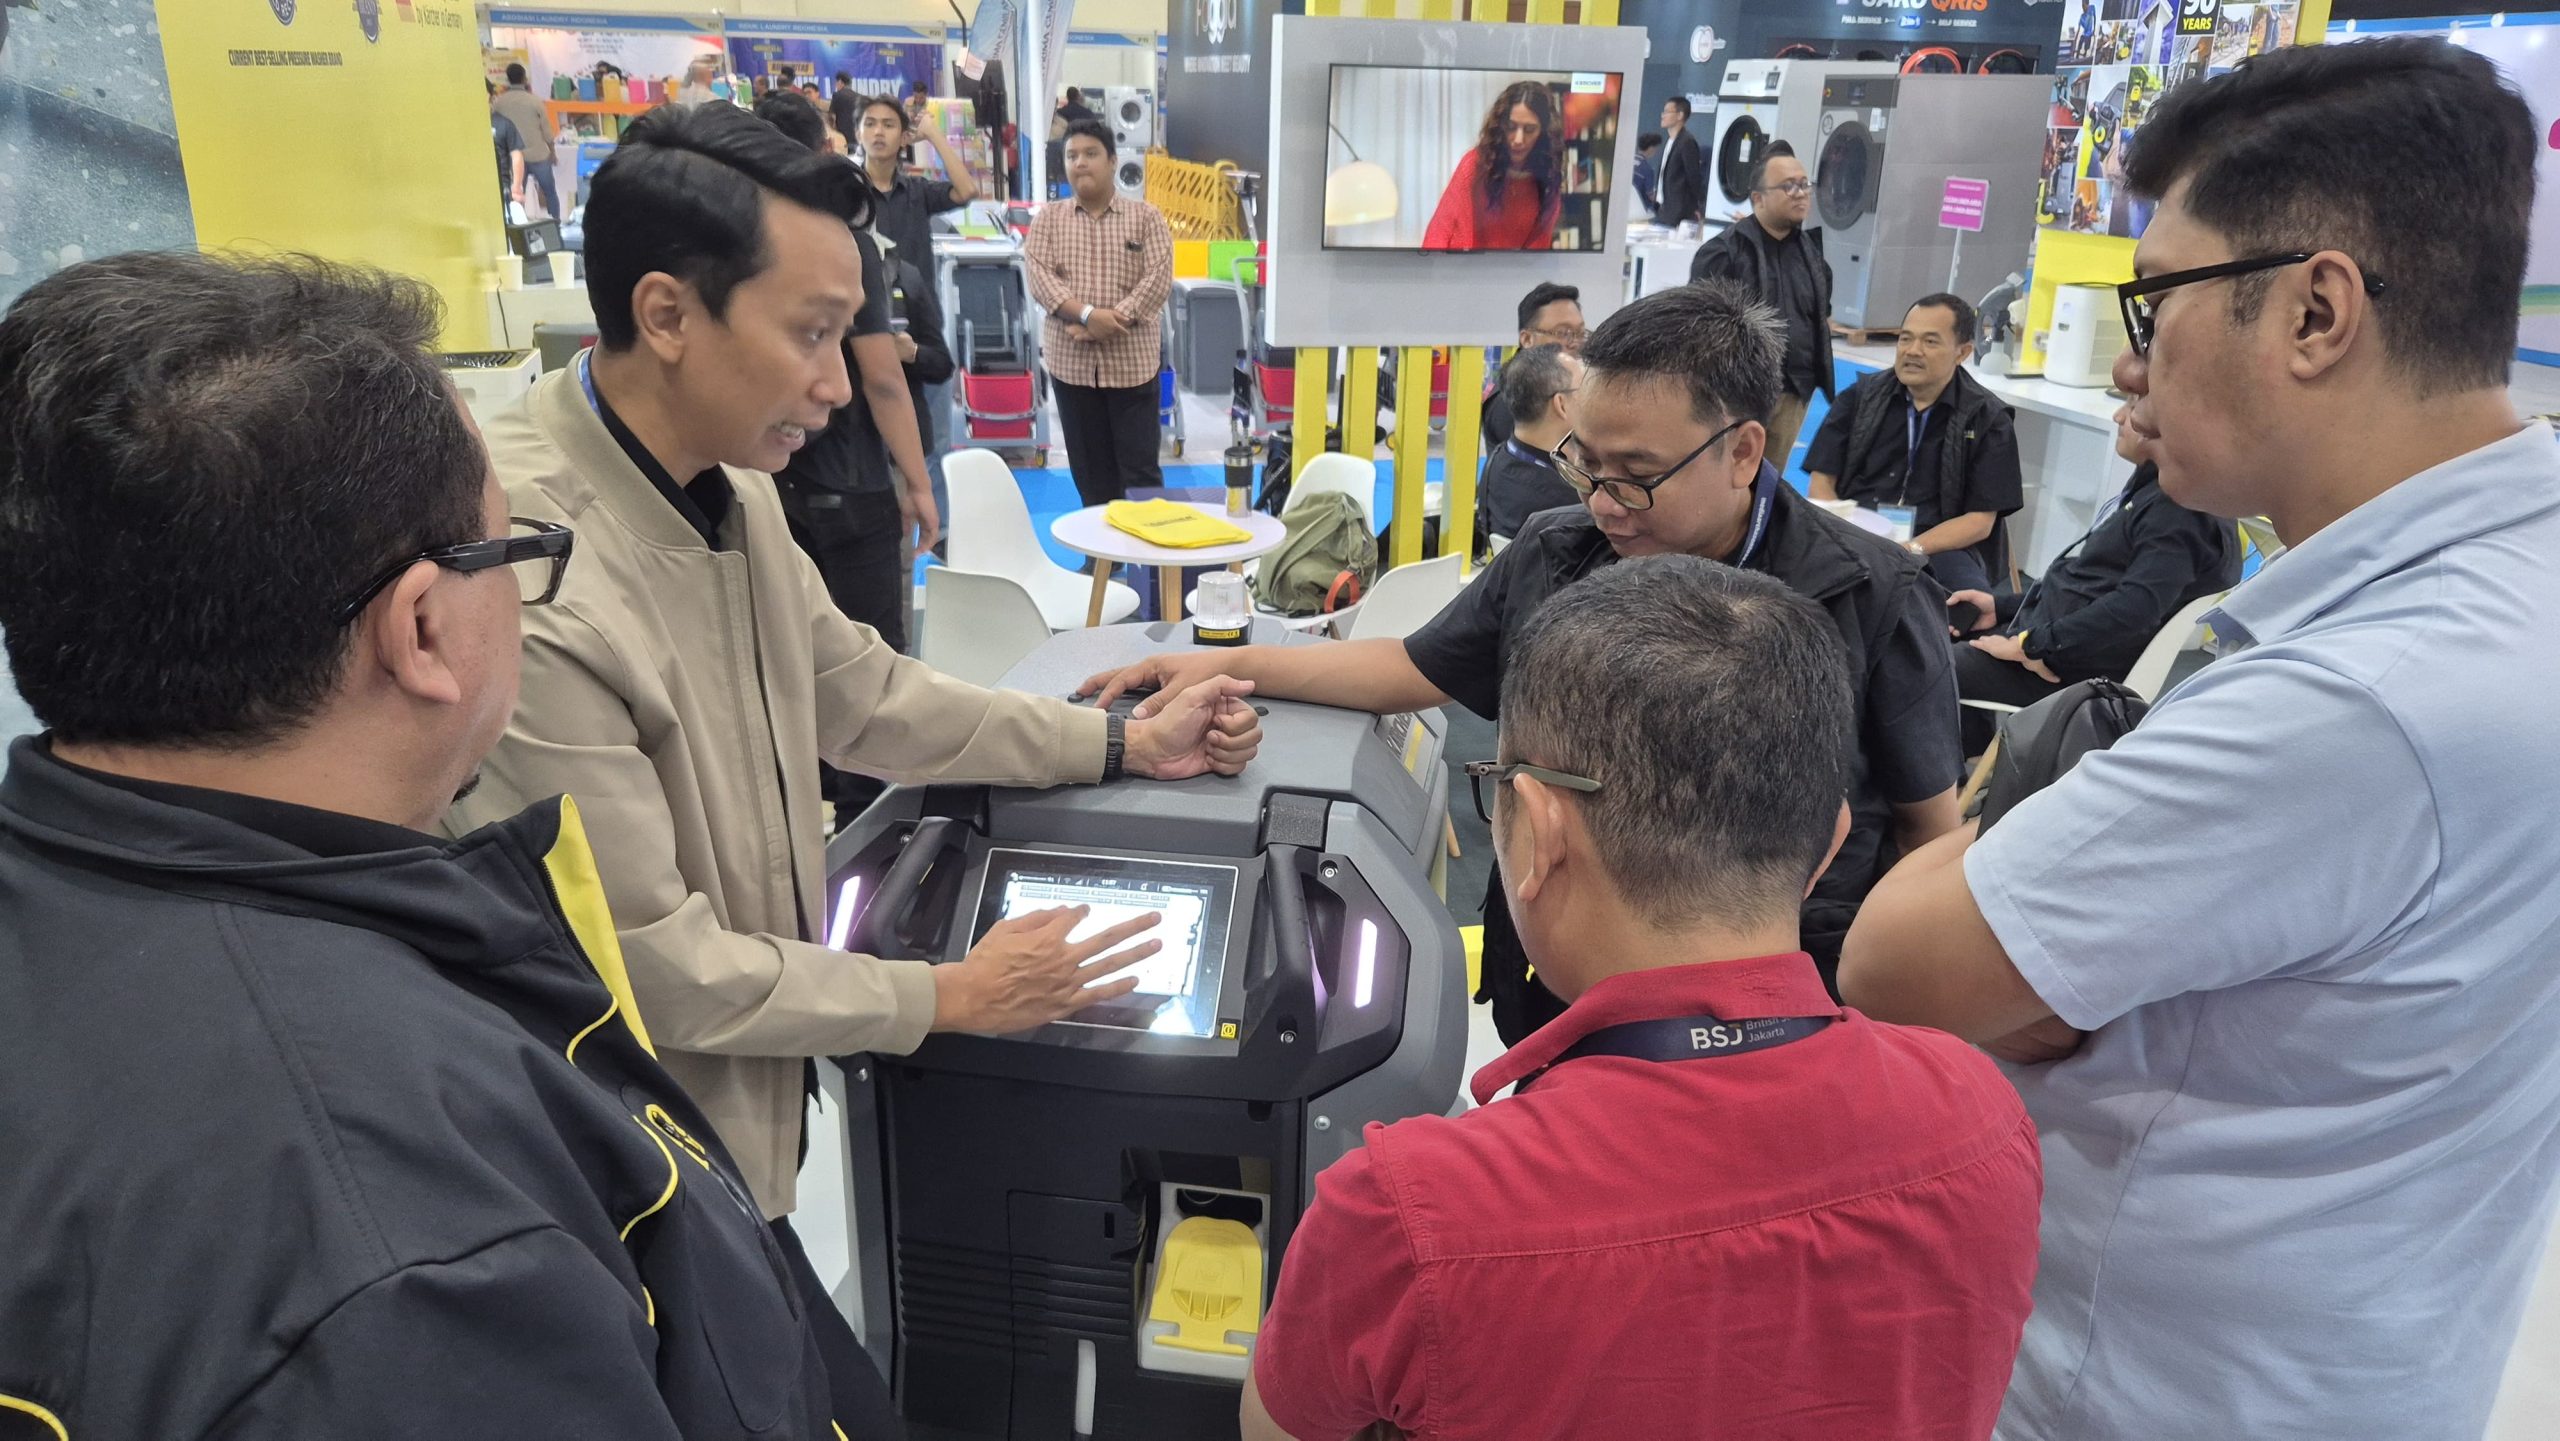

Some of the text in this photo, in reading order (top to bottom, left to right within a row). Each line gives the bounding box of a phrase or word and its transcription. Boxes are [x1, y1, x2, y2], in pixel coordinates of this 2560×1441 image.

[2182, 17, 2213, 30] YEARS
[228, 49, 254, 66] CURRENT
[253, 50, 288, 66] BEST-SELLING
[287, 51, 312, 66] PRESSURE
[1690, 1023, 1743, 1049] BSJ
[1748, 1027, 1785, 1042] Jakarta
